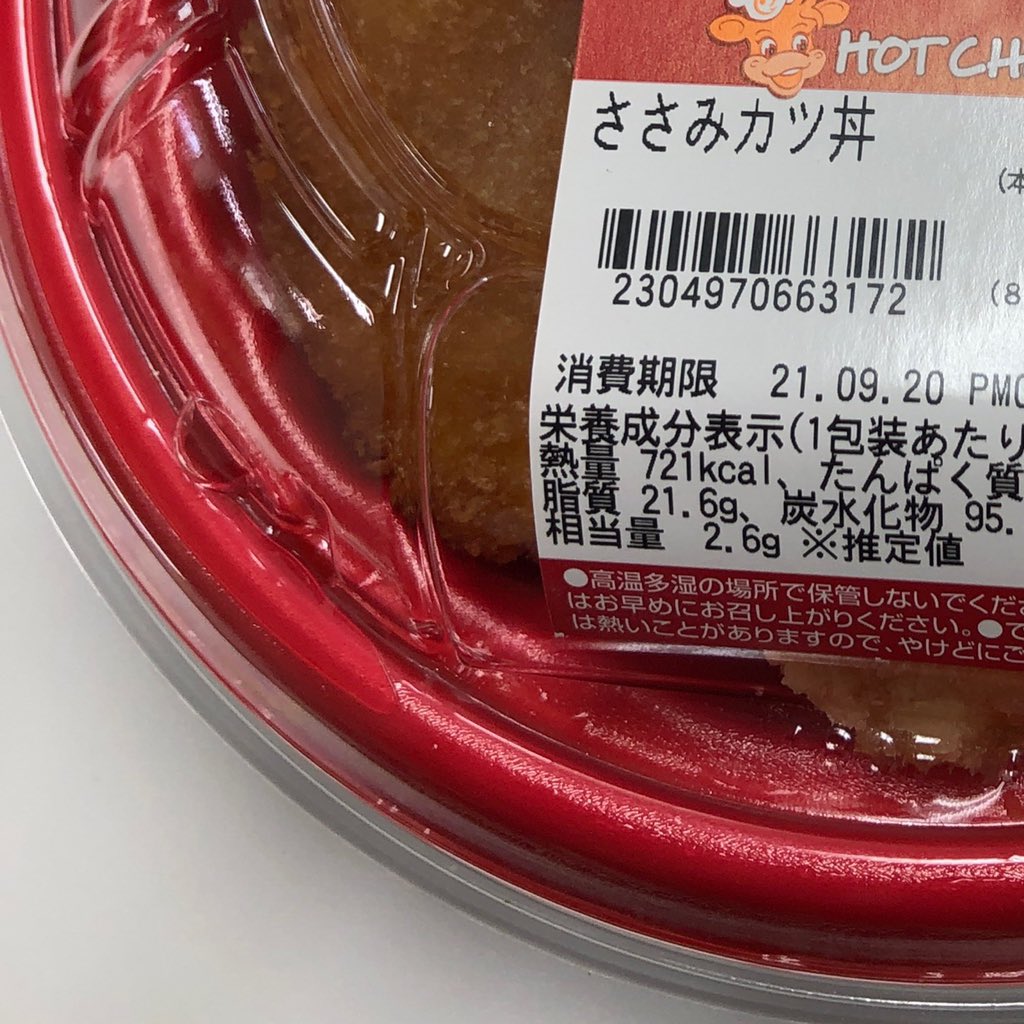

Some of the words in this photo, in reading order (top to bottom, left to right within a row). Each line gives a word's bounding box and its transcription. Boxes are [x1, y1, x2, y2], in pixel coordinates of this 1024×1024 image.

[835, 30, 949, 76] HOT
[593, 91, 875, 162] ささみカツ丼
[612, 273, 907, 316] 2304970663172
[555, 352, 719, 399] 消費期限
[770, 363, 945, 405] 21.09.20
[539, 441, 621, 485] 熱量
[542, 477, 622, 517] 脂質
[545, 512, 666, 552] 相当量
[703, 522, 781, 558] 2.6g
